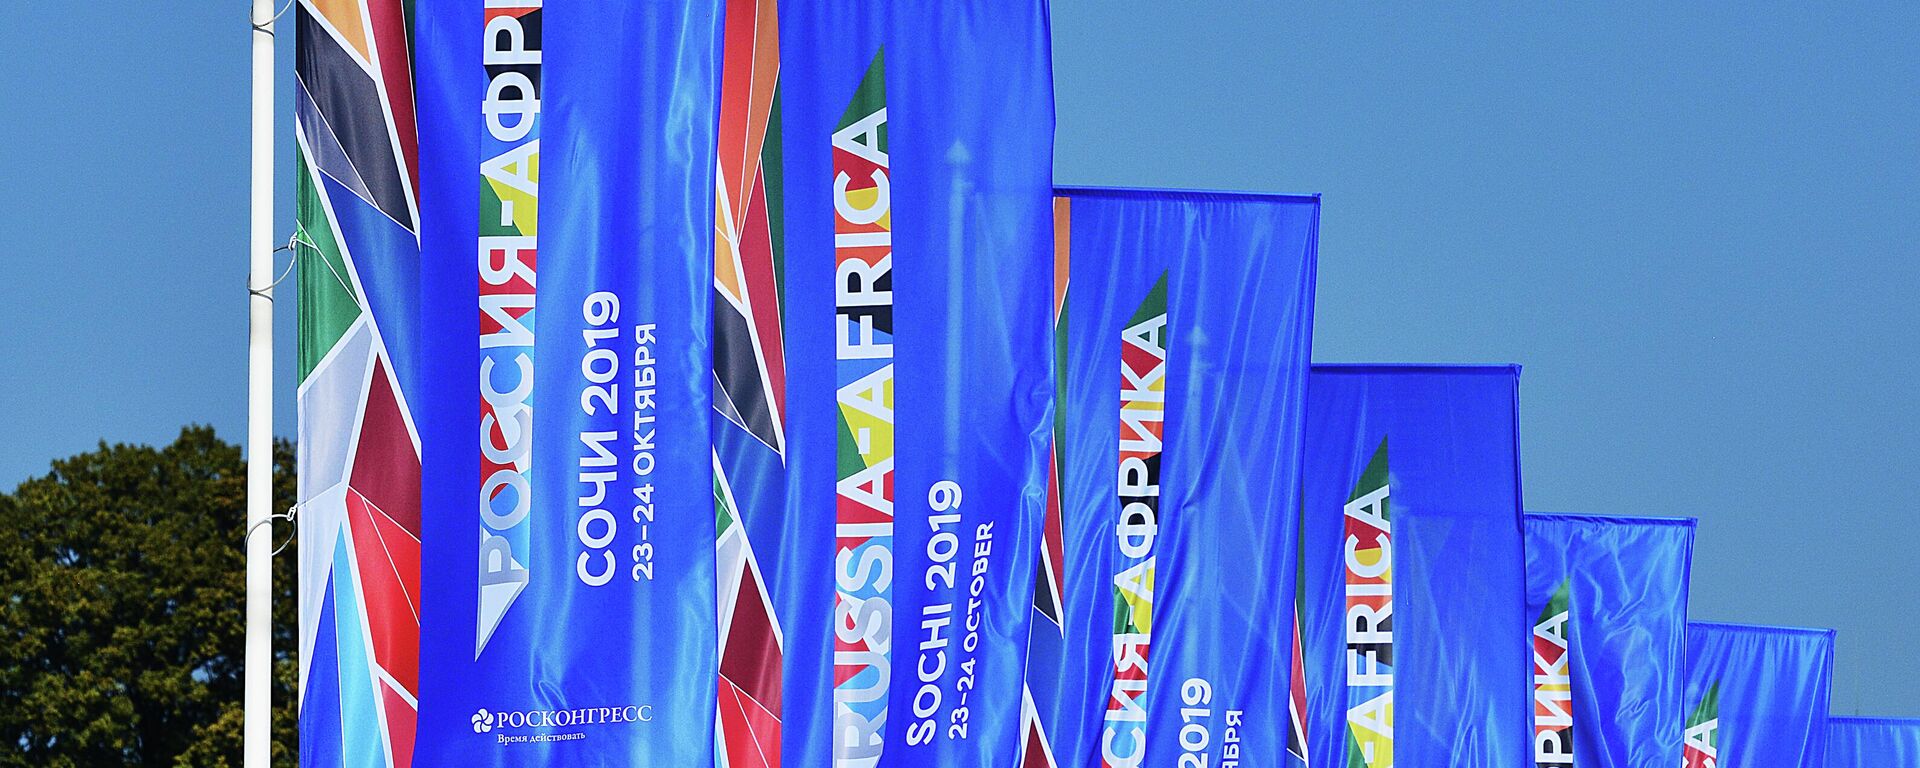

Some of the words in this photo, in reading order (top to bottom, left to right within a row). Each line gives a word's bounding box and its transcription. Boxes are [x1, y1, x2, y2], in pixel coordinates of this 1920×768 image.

[479, 0, 543, 585] РОССИЯ-АФР
[581, 291, 620, 416] 2019
[633, 323, 656, 476] ОКТЯБРЯ
[832, 106, 894, 768] RUSSIA-AFRICA
[576, 430, 618, 587] СОЧИ
[925, 480, 963, 591] 2019
[963, 520, 994, 652] OCTOBER
[1344, 484, 1393, 768] -AFRICA
[497, 705, 653, 729] РОСКОНГРЕСС
[497, 733, 528, 746] Время
[529, 732, 586, 744] действовать
[906, 603, 953, 746] SOCHI
[1533, 610, 1574, 768] РИКА
